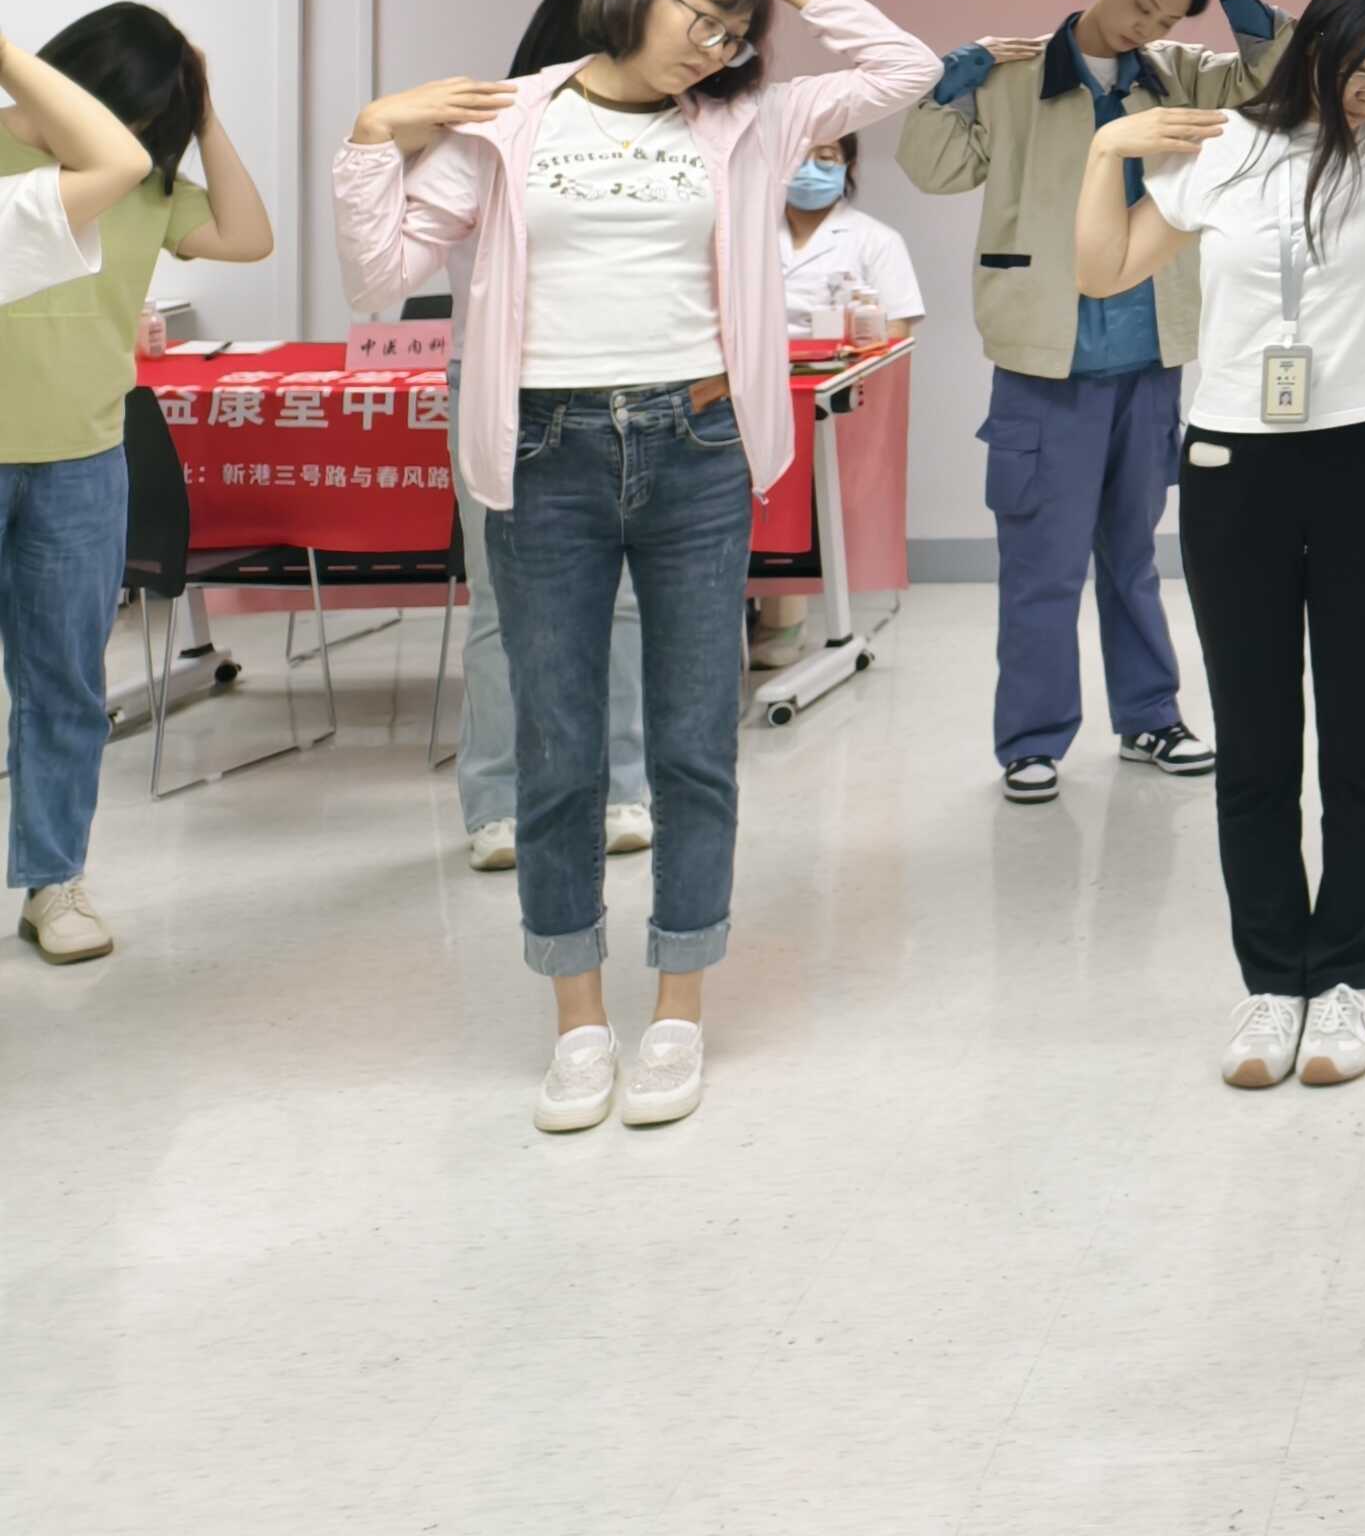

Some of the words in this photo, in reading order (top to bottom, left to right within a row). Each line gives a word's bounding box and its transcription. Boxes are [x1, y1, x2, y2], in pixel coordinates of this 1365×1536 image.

[154, 385, 449, 431] 益康堂中医
